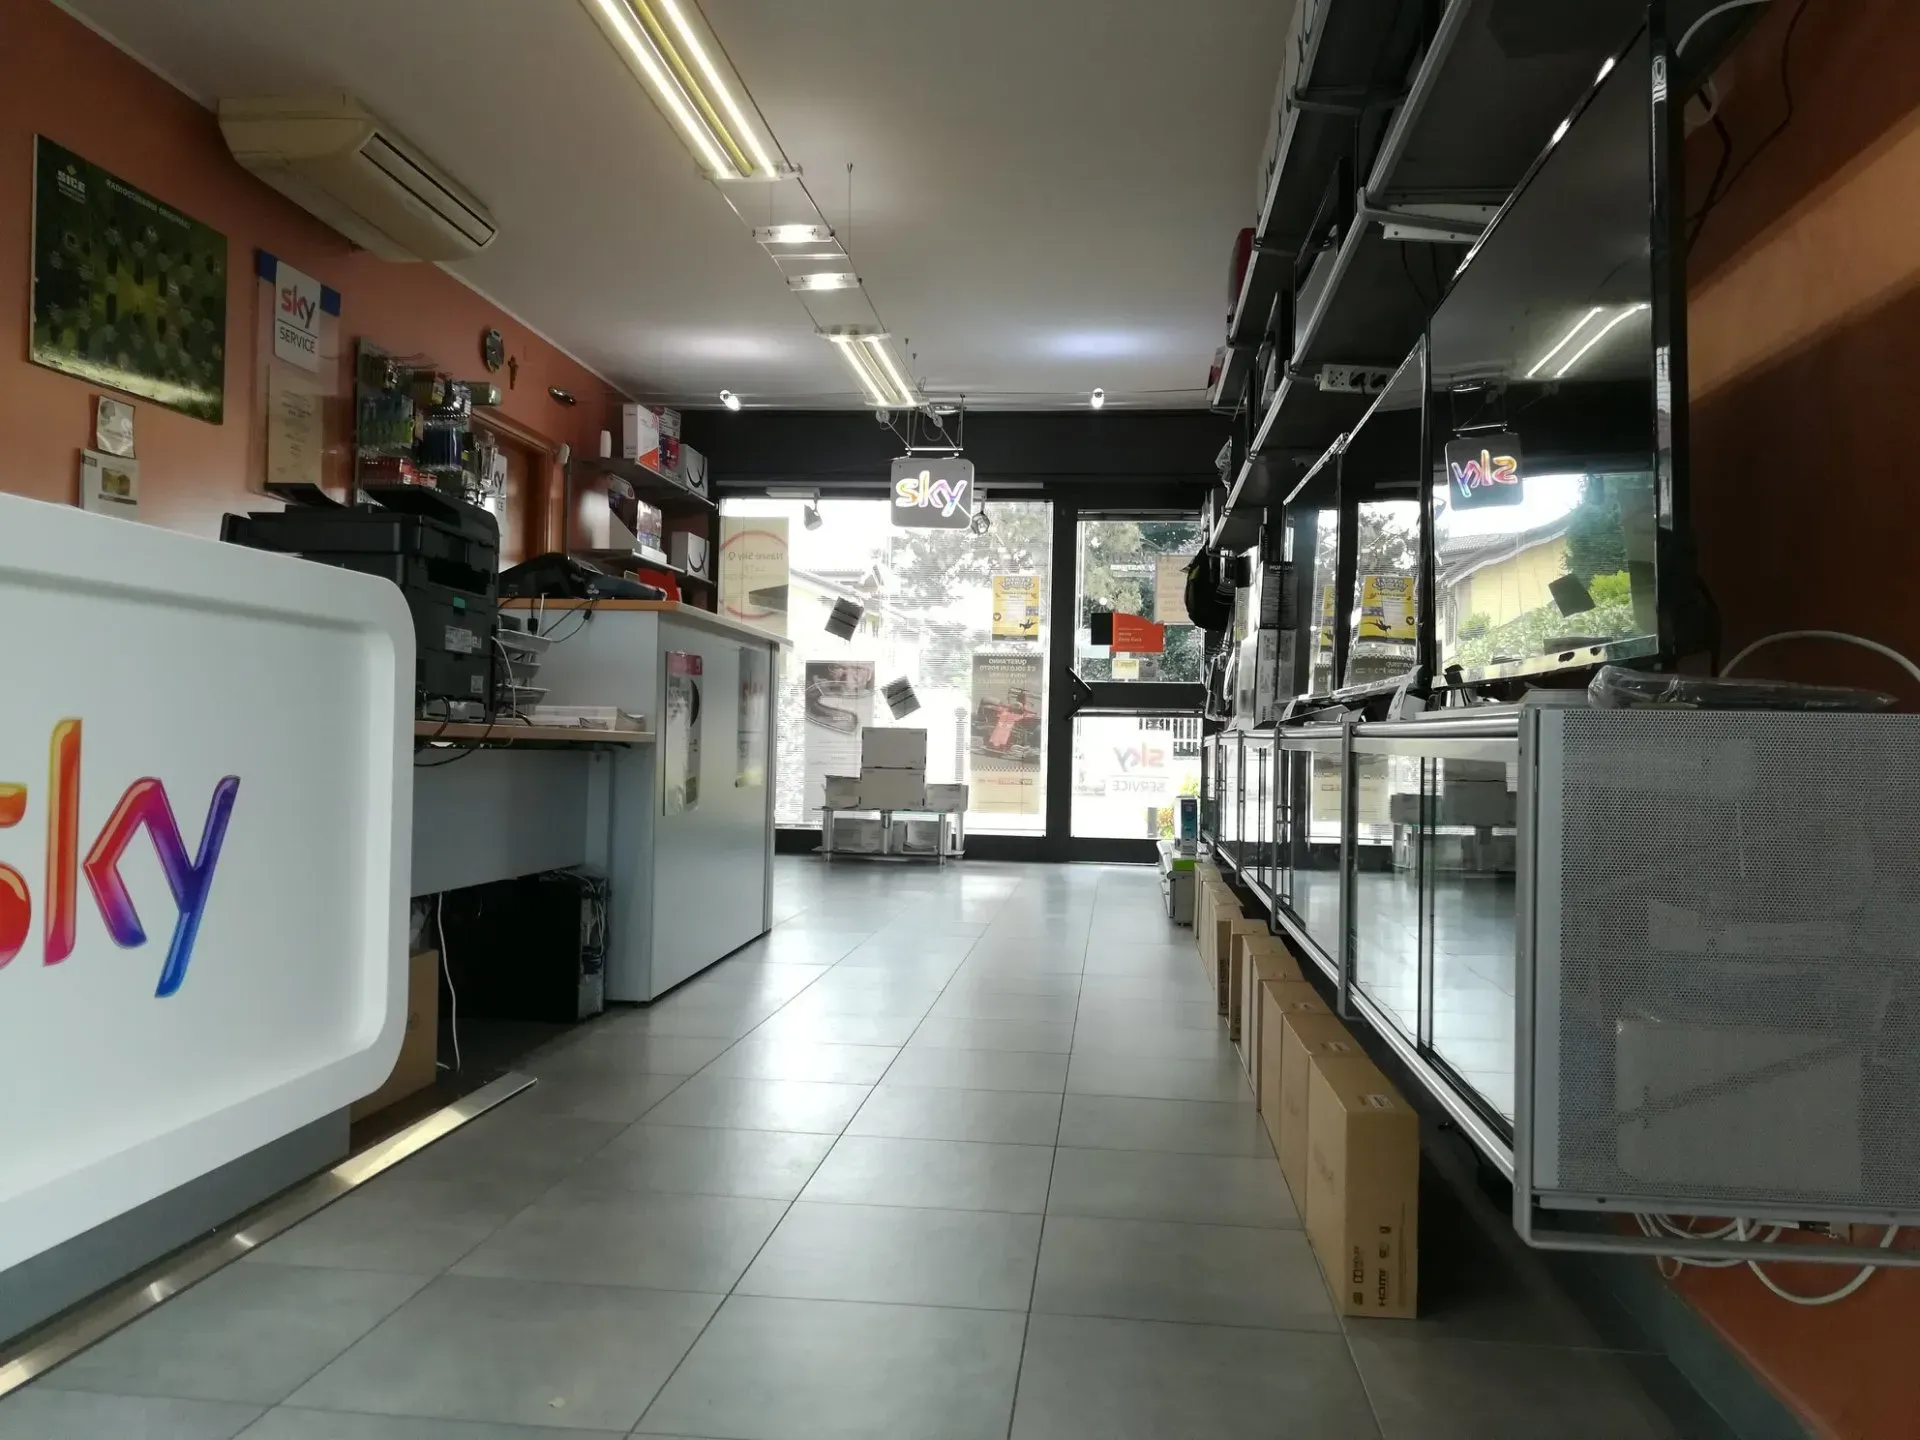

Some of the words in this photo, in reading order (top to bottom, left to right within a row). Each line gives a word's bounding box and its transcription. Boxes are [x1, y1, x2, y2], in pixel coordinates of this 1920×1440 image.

[281, 285, 316, 328] sky
[279, 327, 316, 353] SERVICE
[895, 470, 968, 518] sky
